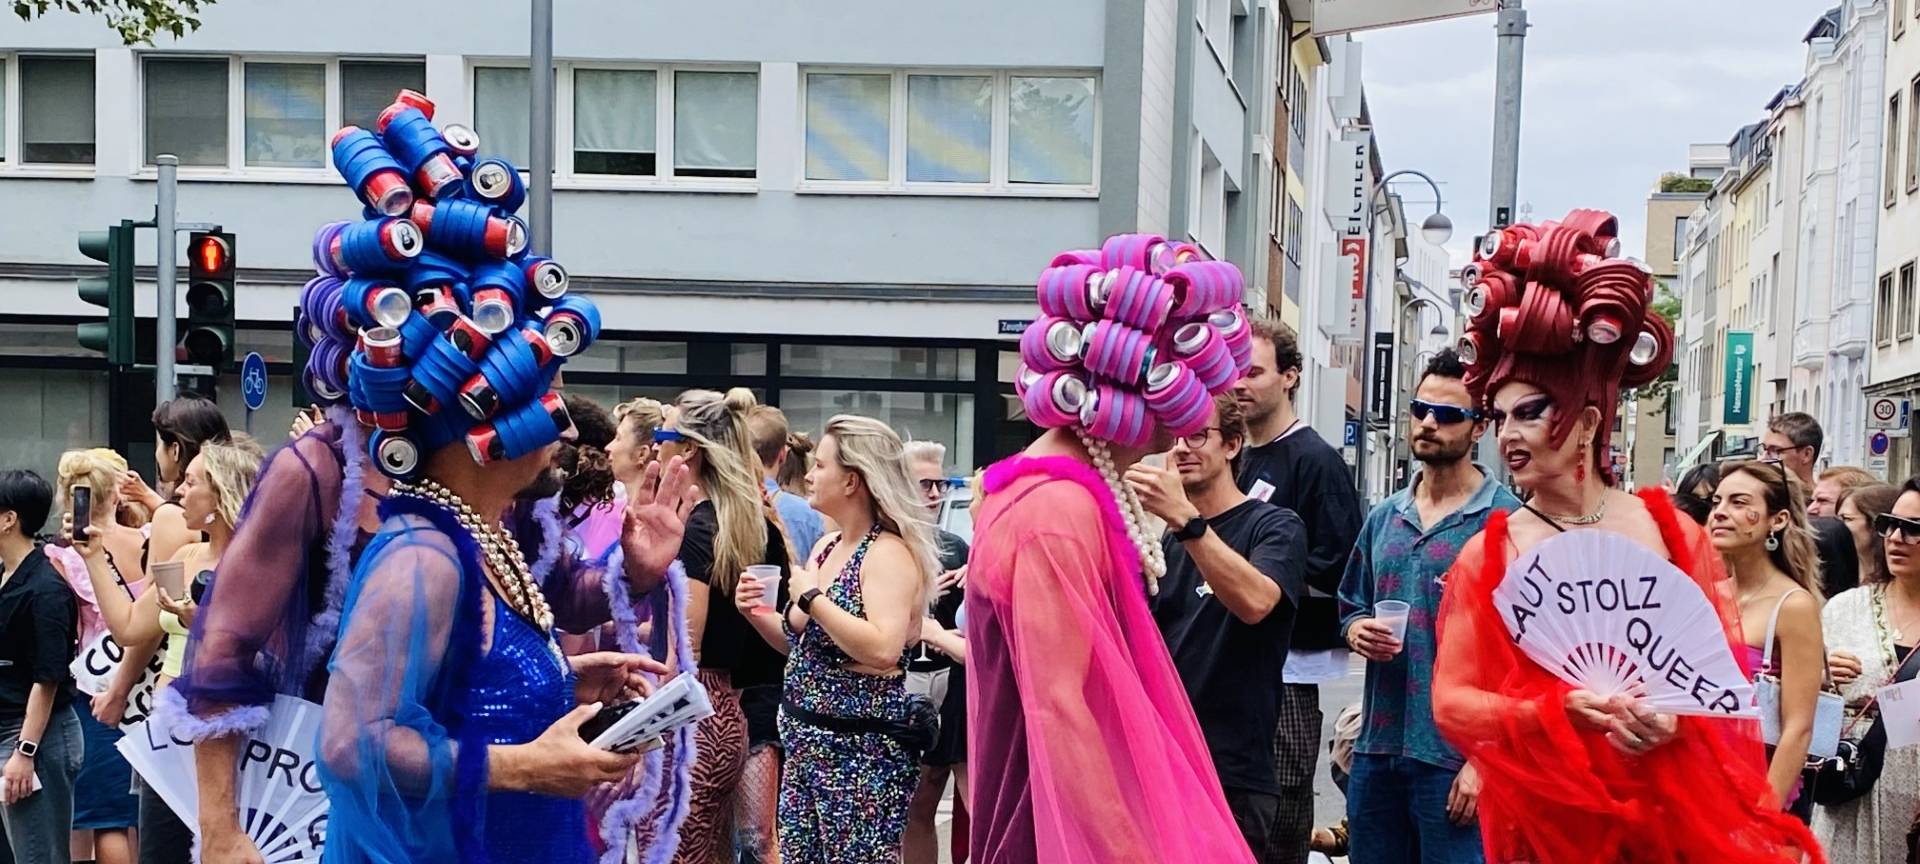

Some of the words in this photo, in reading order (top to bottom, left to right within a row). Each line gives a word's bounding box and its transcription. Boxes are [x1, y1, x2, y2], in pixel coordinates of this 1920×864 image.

[1878, 404, 1891, 415] 30
[1556, 576, 1661, 615] STOLZ
[1626, 617, 1740, 714] QUEER
